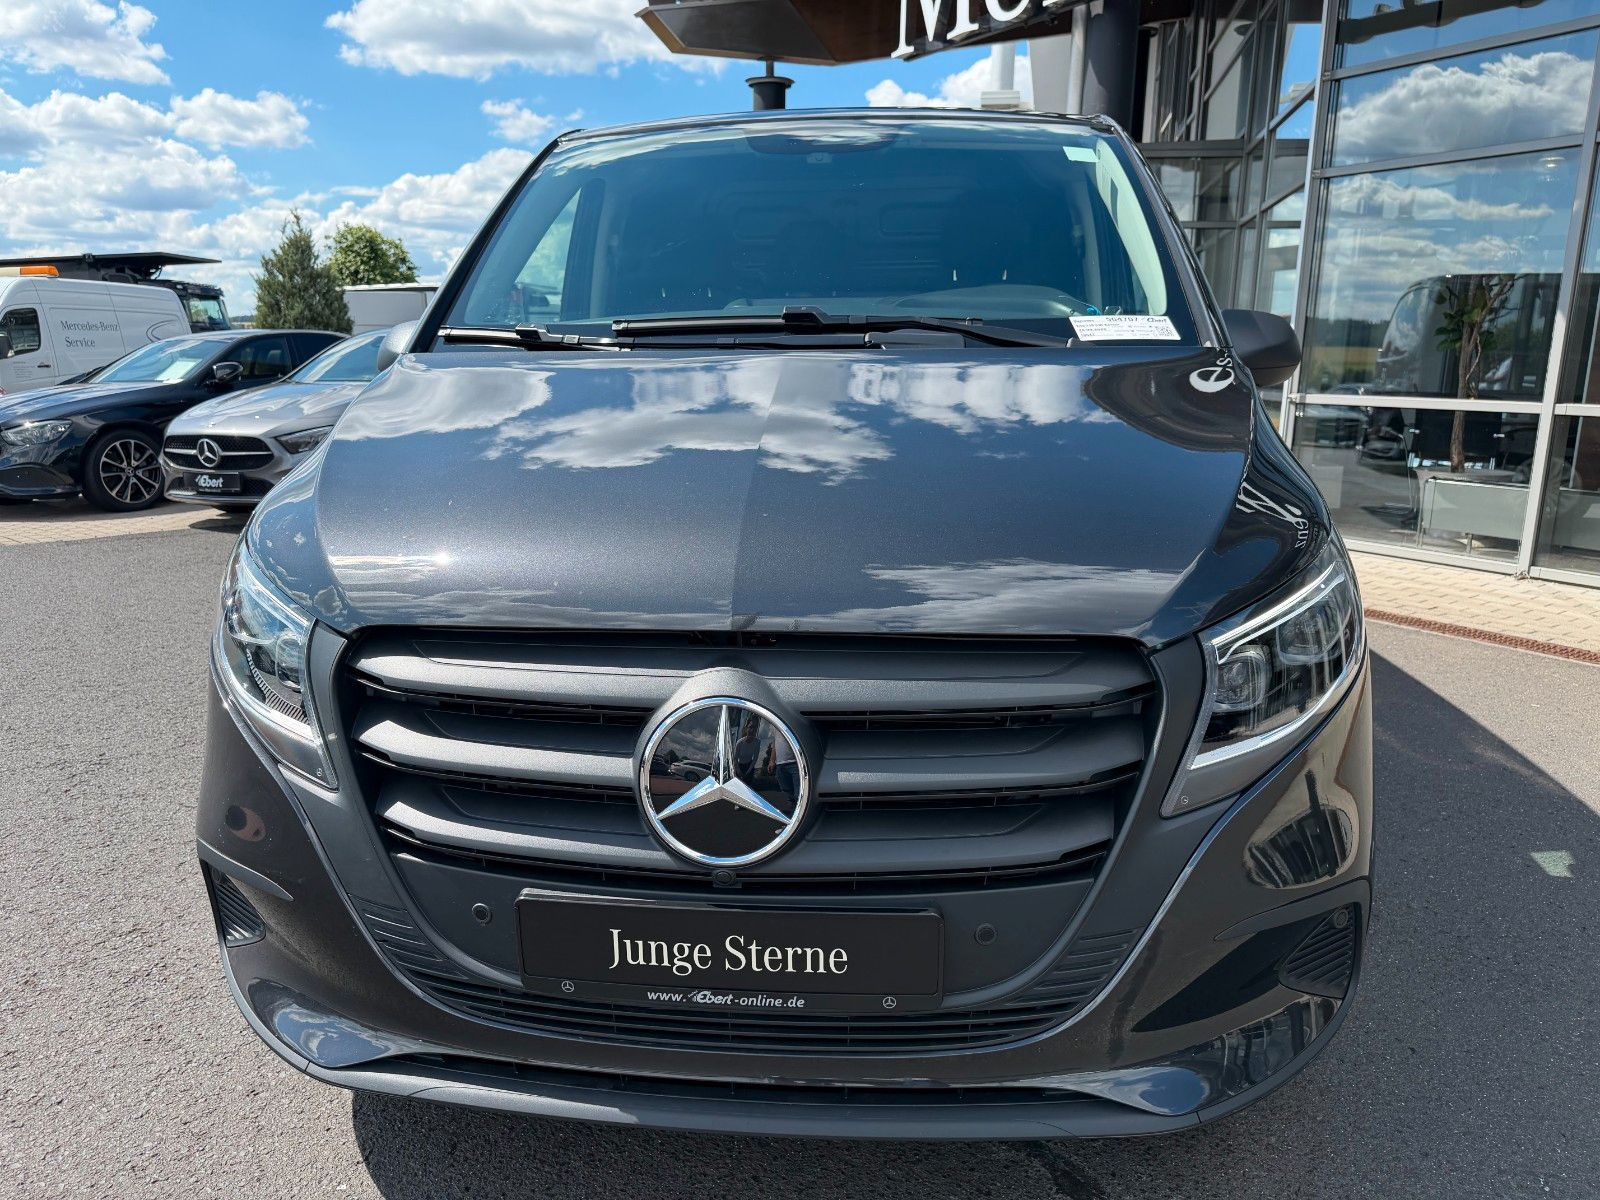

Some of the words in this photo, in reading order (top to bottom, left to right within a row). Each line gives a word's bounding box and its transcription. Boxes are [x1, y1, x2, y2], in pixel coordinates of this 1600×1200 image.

[60, 320, 119, 332] Mercedes-Benz
[64, 336, 96, 348] Service
[608, 928, 712, 976] Junge
[724, 934, 848, 974] Sterne
